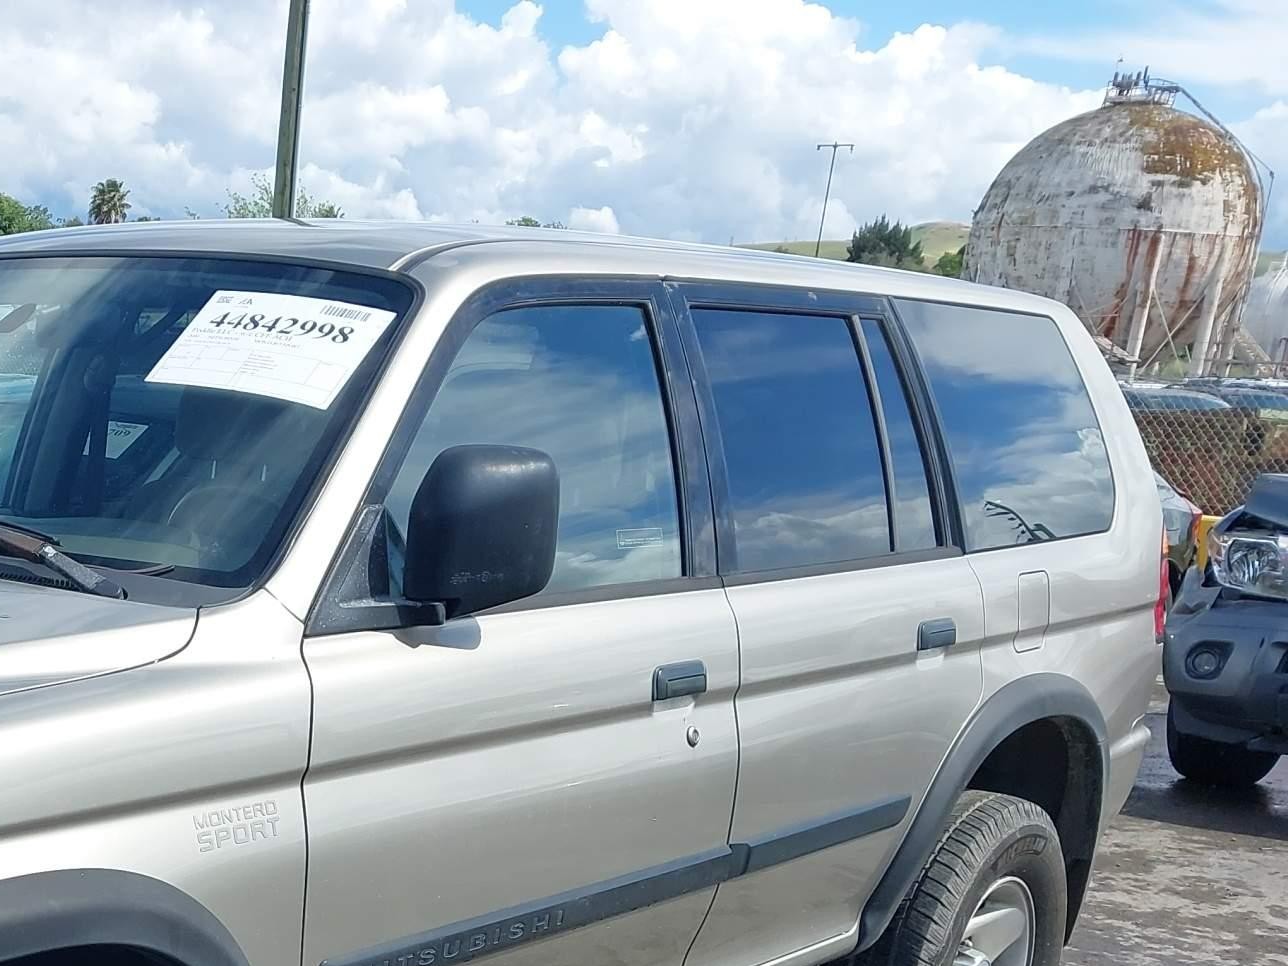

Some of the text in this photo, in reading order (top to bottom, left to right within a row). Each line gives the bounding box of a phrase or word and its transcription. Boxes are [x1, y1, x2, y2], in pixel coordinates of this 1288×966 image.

[210, 311, 355, 344] 44842998
[192, 799, 278, 830] MONTERO
[196, 816, 280, 853] SPORT
